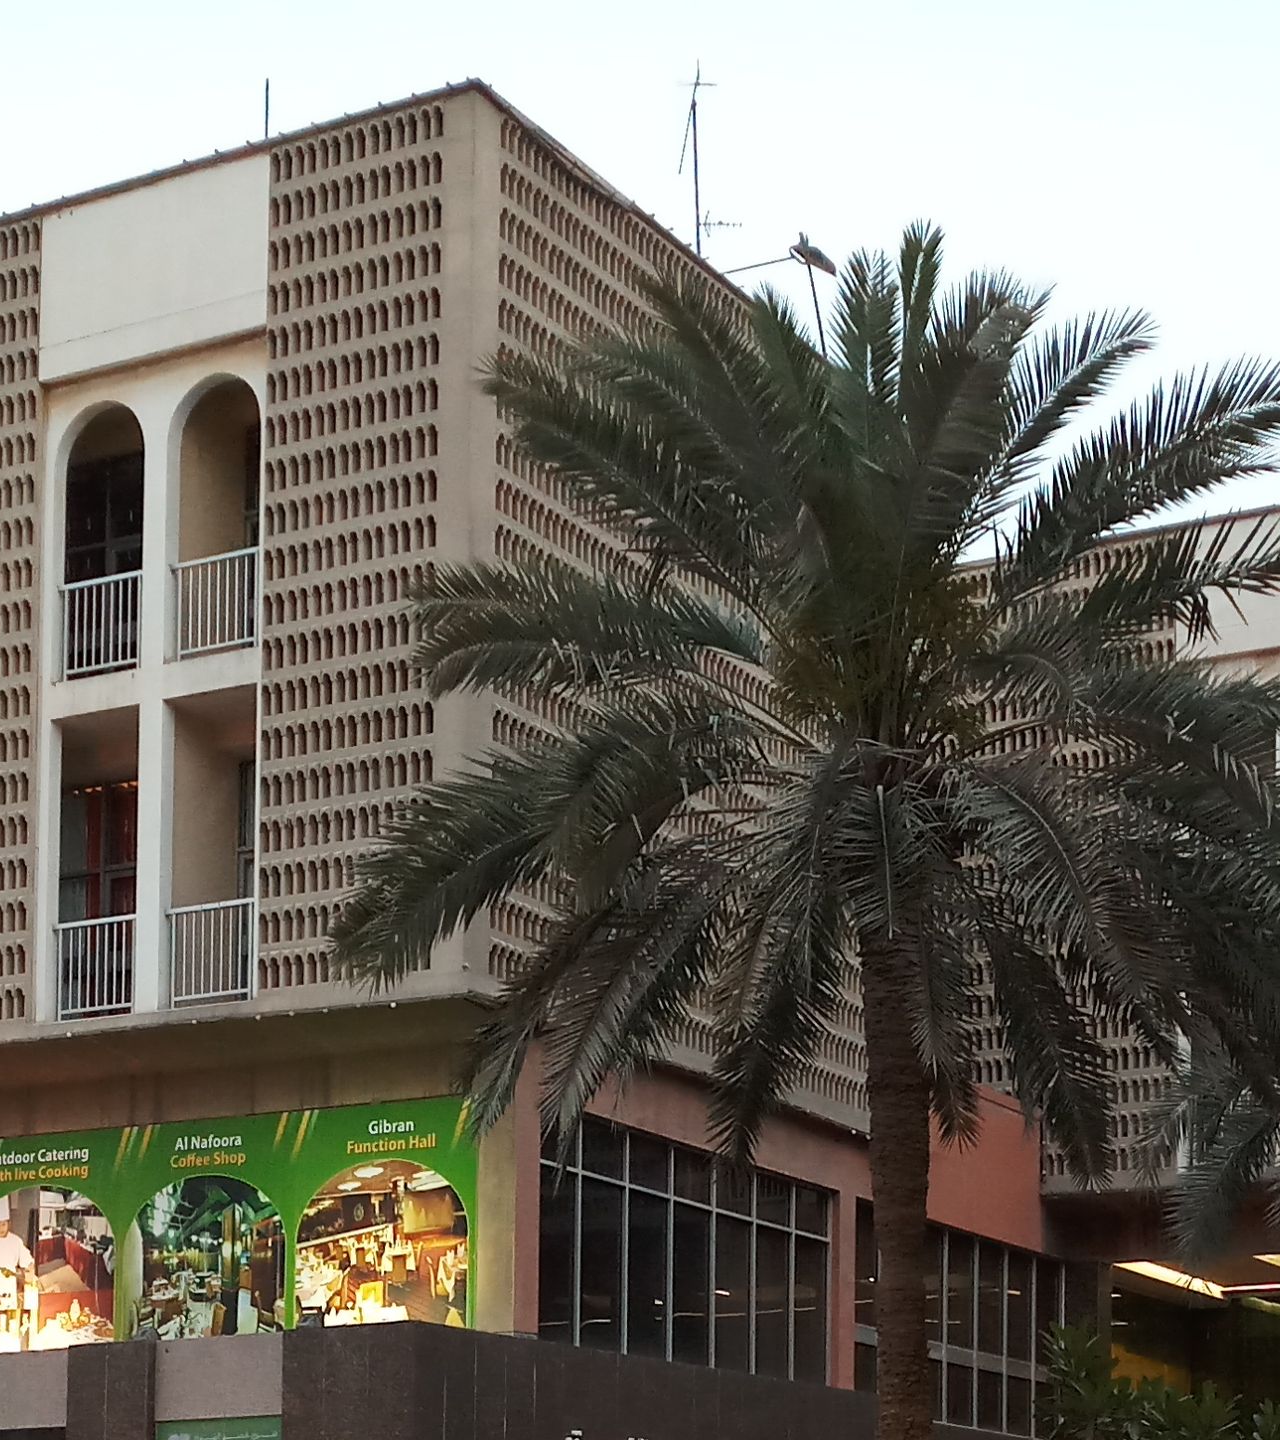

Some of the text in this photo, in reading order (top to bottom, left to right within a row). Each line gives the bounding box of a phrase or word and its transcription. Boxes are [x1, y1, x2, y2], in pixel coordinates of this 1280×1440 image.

[368, 1119, 414, 1134] Gibran
[174, 1134, 242, 1151] Al Nafoora
[347, 1132, 436, 1154] Function Hall
[37, 1146, 89, 1162] Catering
[170, 1151, 246, 1168] Coffee Shop
[14, 1167, 36, 1181] live
[38, 1164, 89, 1179] Cooking
